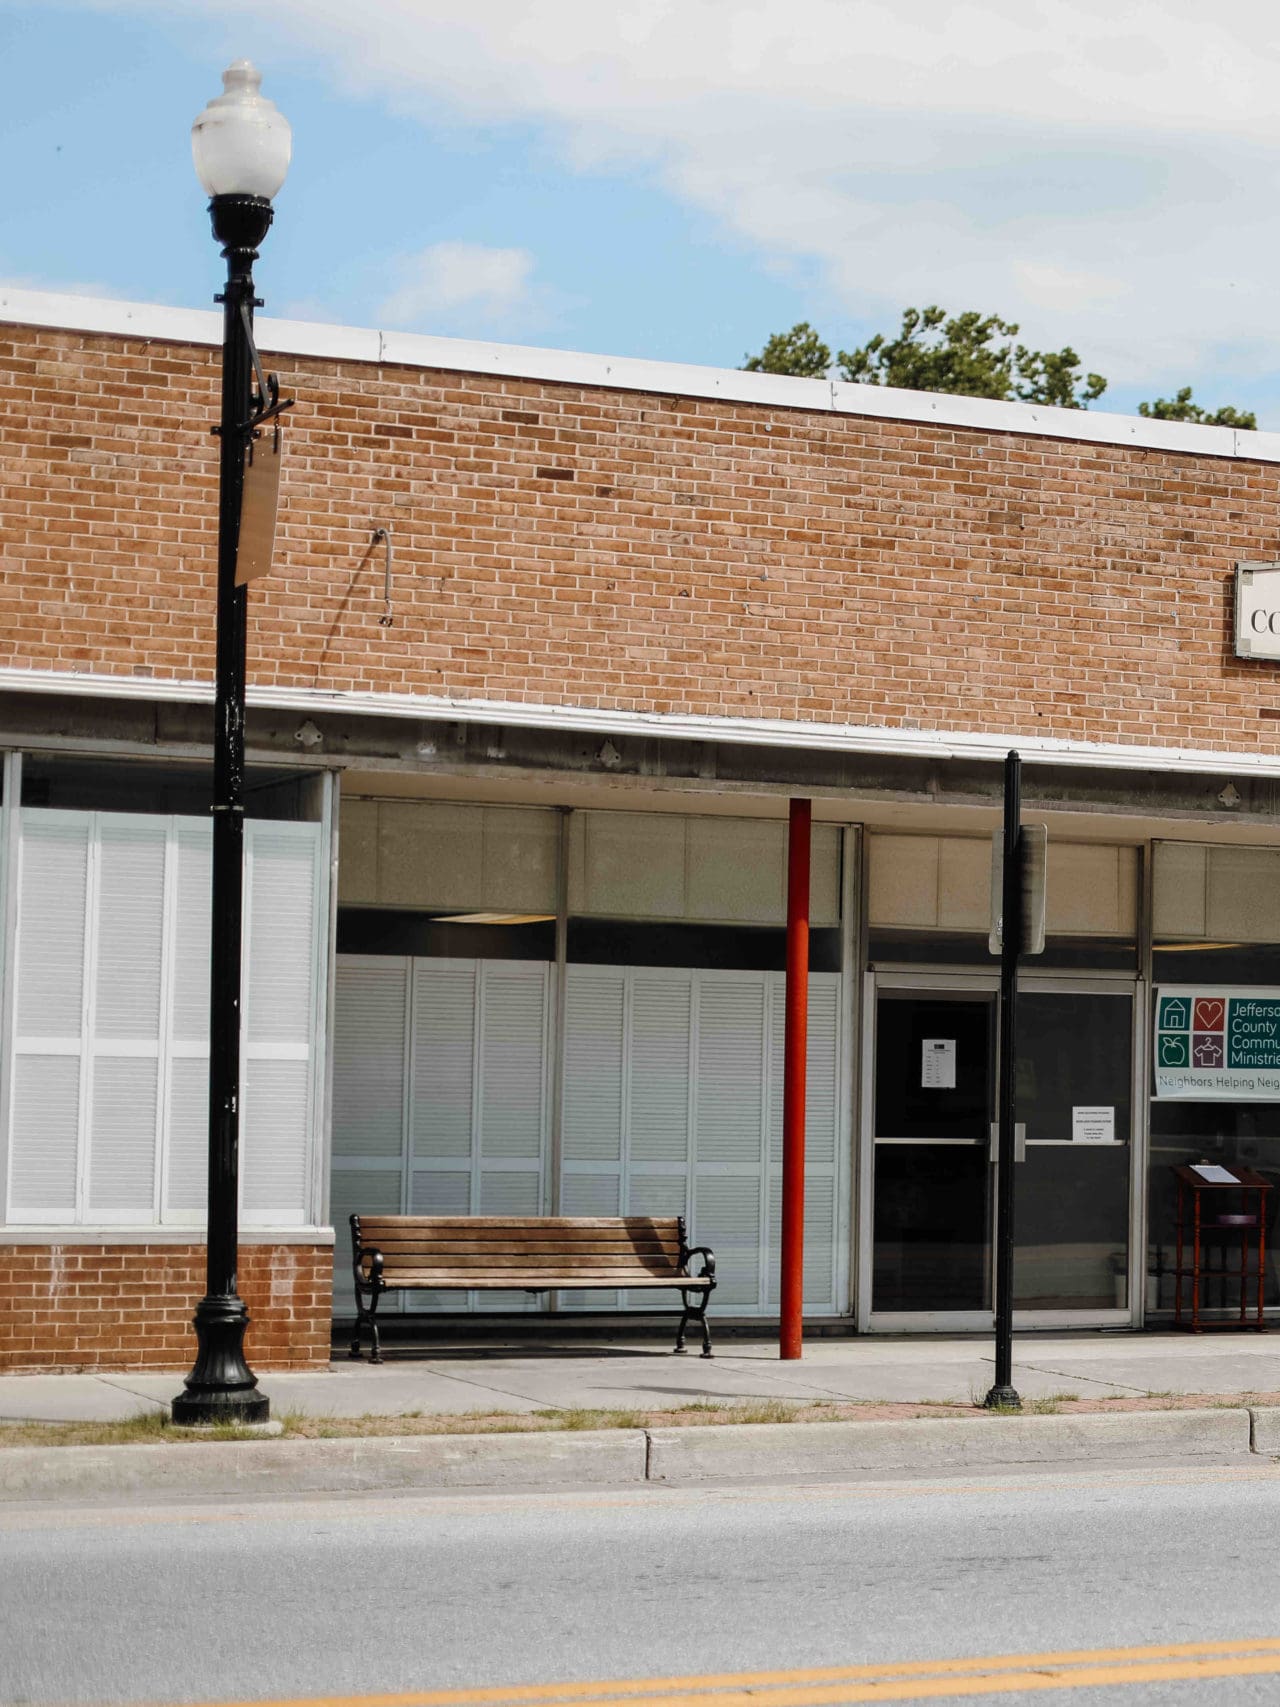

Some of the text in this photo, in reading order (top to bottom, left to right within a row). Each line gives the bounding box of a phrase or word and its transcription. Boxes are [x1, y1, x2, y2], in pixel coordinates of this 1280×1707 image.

[1231, 1018, 1277, 1036] County
[1159, 1075, 1213, 1089] Neighbors
[1216, 1074, 1255, 1089] Helping
